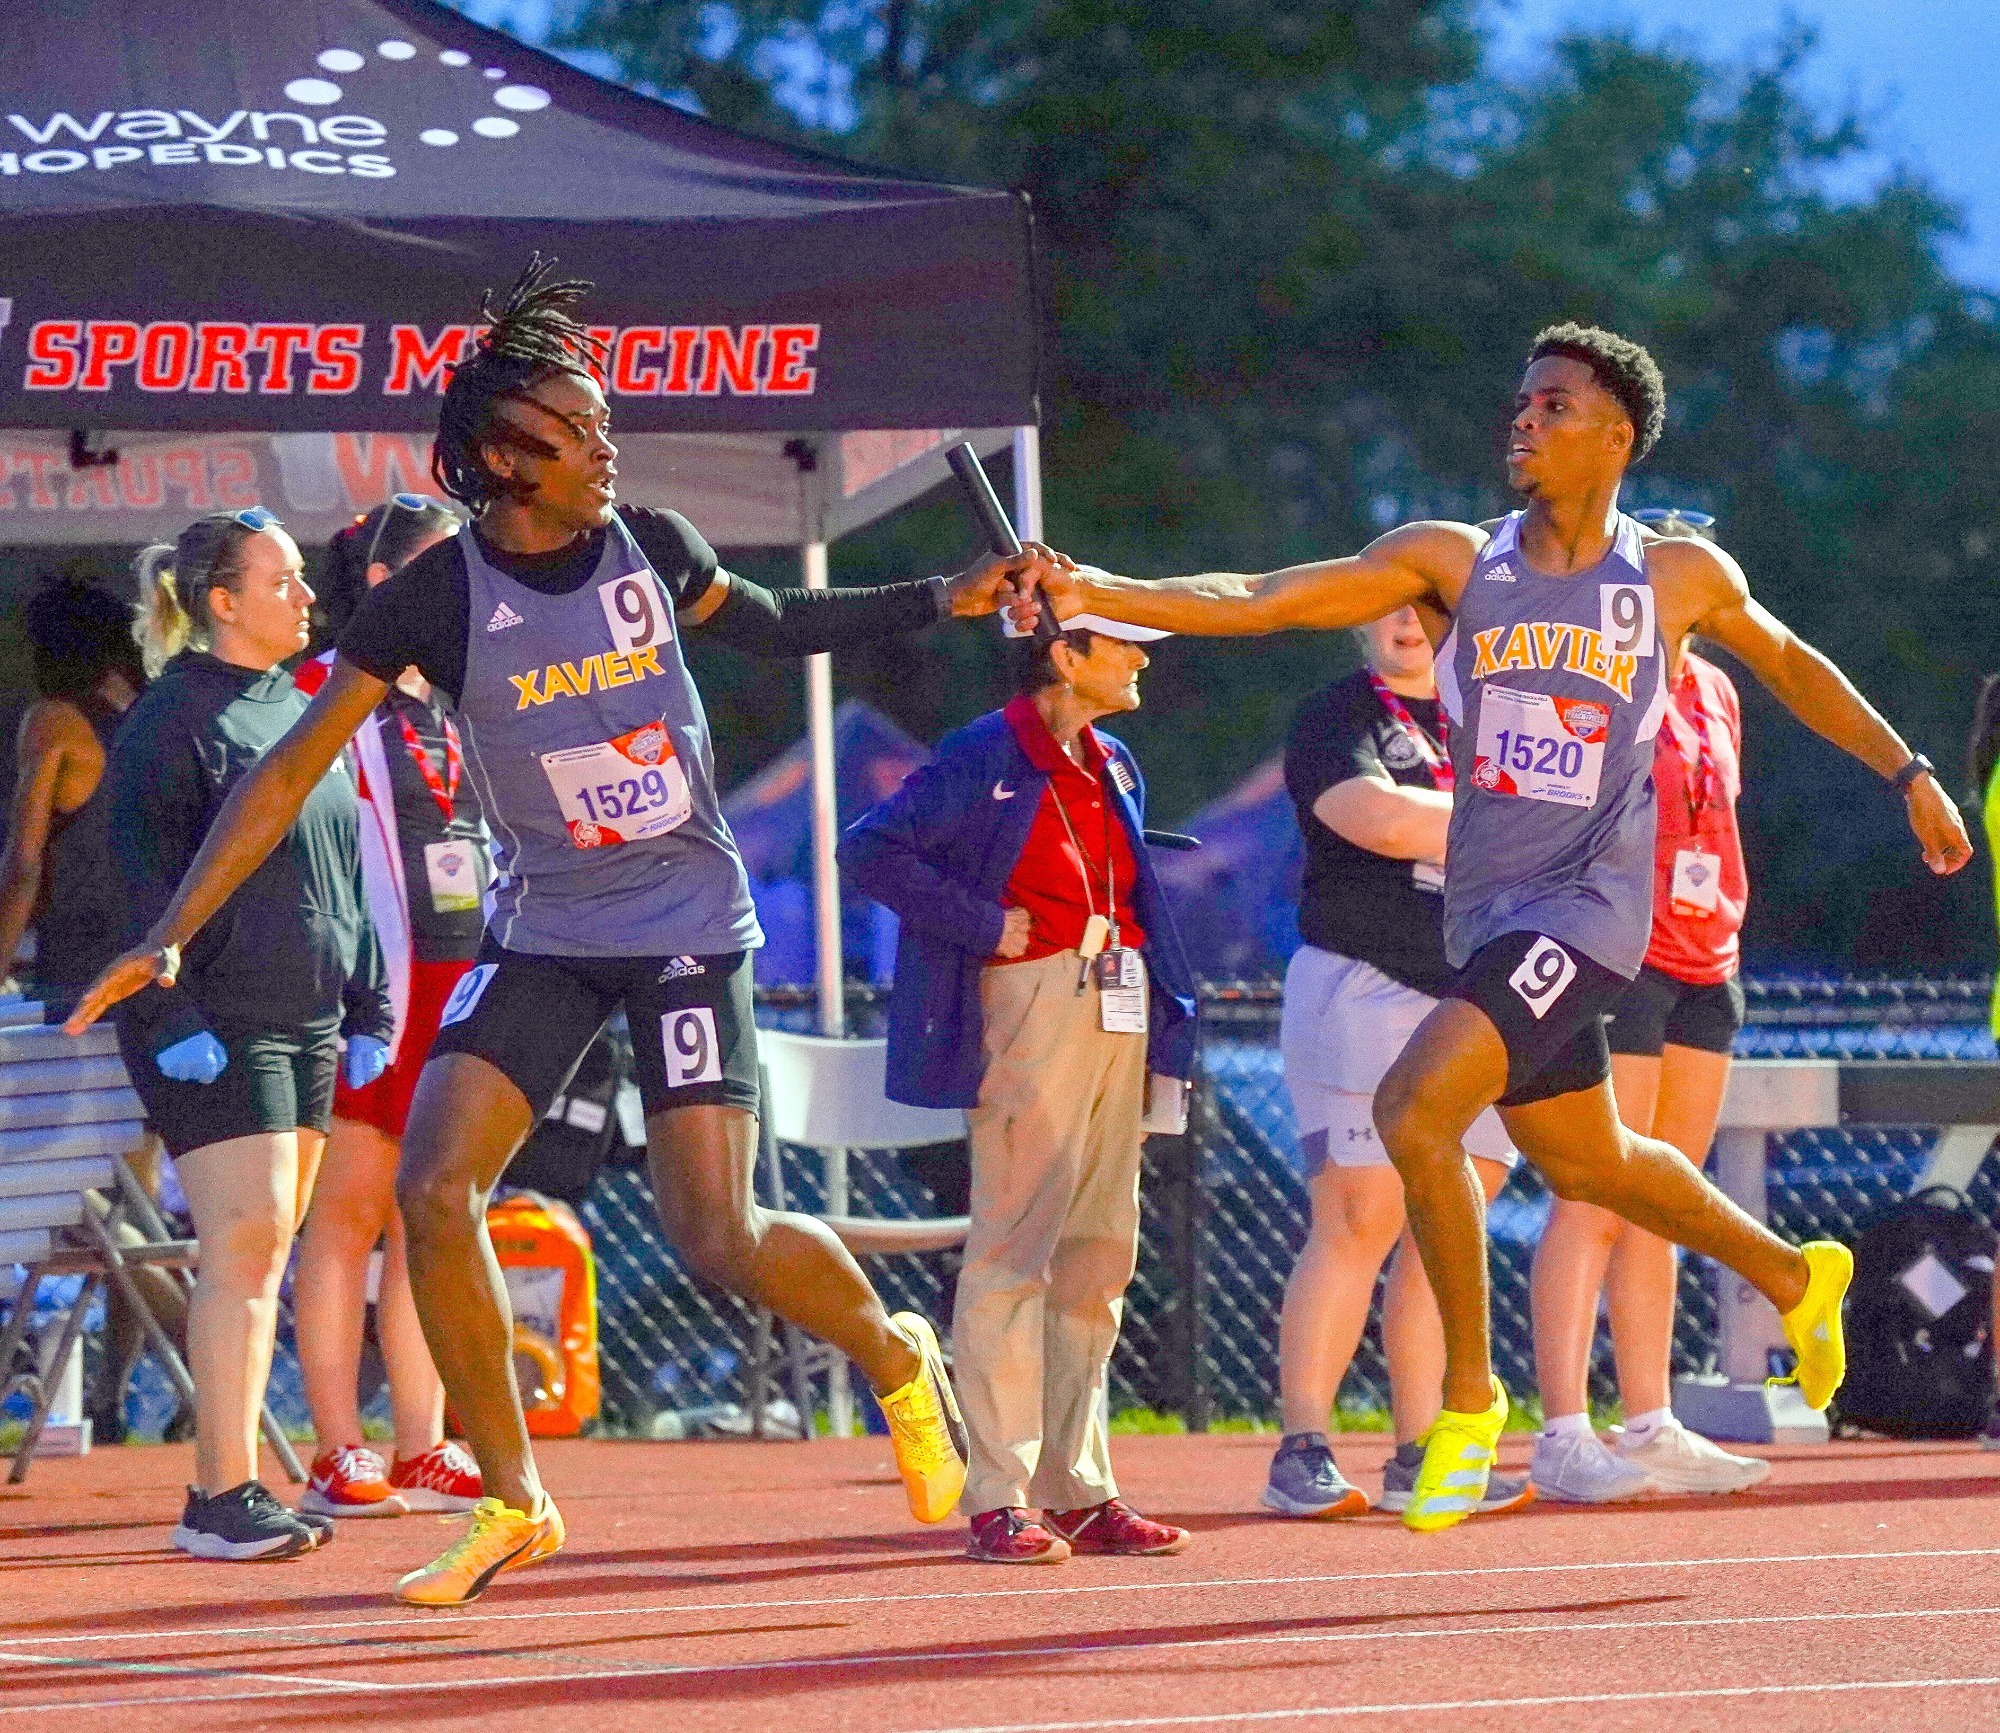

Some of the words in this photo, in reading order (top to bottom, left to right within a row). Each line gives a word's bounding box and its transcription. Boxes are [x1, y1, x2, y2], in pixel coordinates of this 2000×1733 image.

[6, 109, 388, 147] wayne
[24, 319, 366, 395] SPORTS
[384, 323, 821, 397] MICINE
[1485, 573, 1517, 583] adidas
[487, 615, 524, 632] adidas
[614, 579, 655, 648] 9
[1612, 587, 1643, 652] 9
[508, 646, 667, 711] XAVIER
[1472, 621, 1639, 704] XAVIER
[1496, 729, 1584, 778] 1520
[576, 770, 669, 821] 1529
[447, 967, 484, 1019] 9
[657, 963, 706, 985] adidas
[1519, 948, 1566, 999] 9
[673, 1012, 709, 1080] 9
